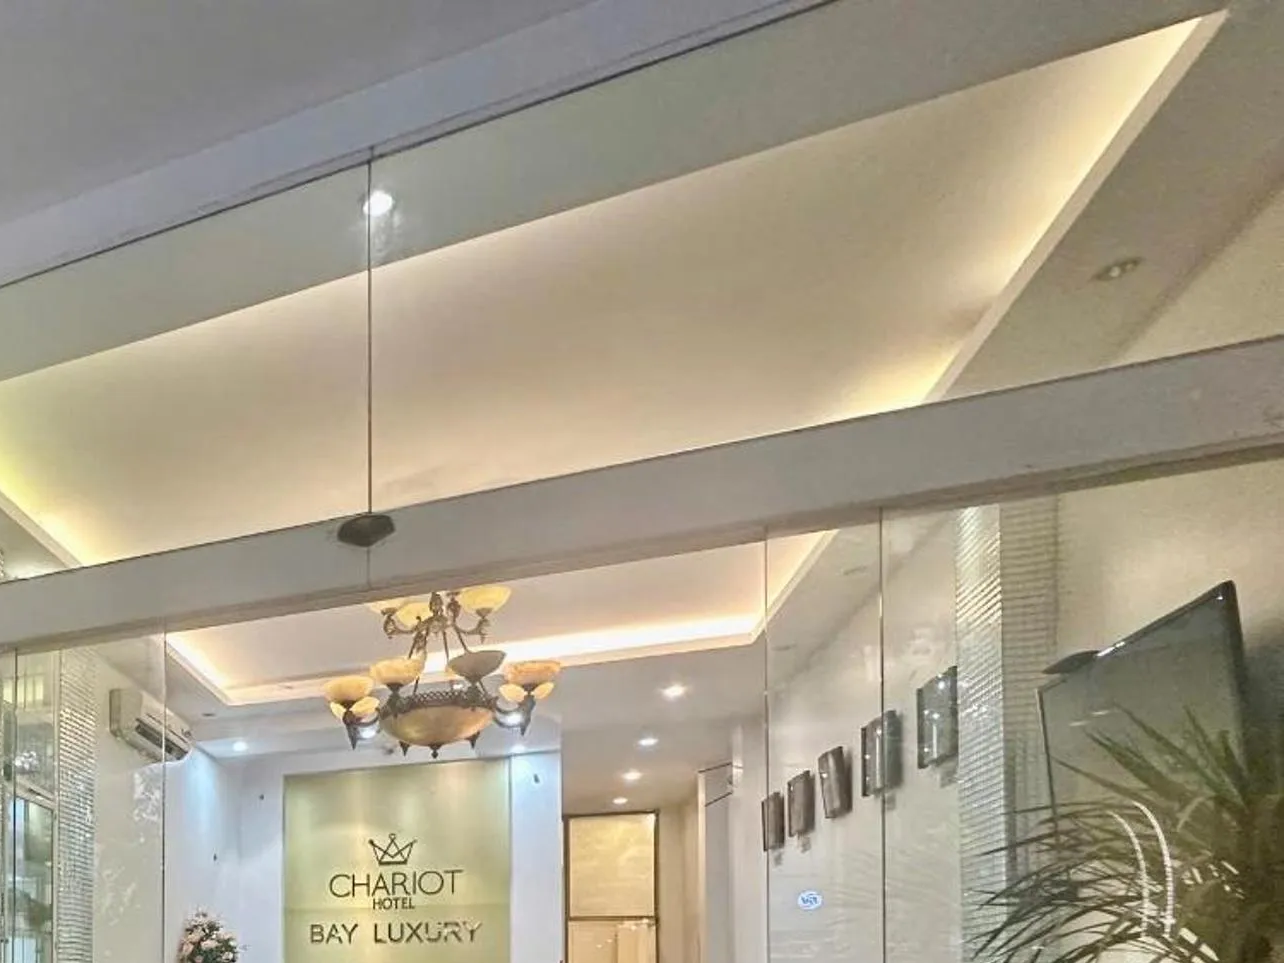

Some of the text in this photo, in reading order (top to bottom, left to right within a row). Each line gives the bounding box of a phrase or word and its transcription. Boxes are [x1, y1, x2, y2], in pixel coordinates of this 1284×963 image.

[328, 869, 465, 898] CHARIOT
[372, 897, 416, 911] HOTEL
[310, 919, 483, 945] BAY LUXURY
